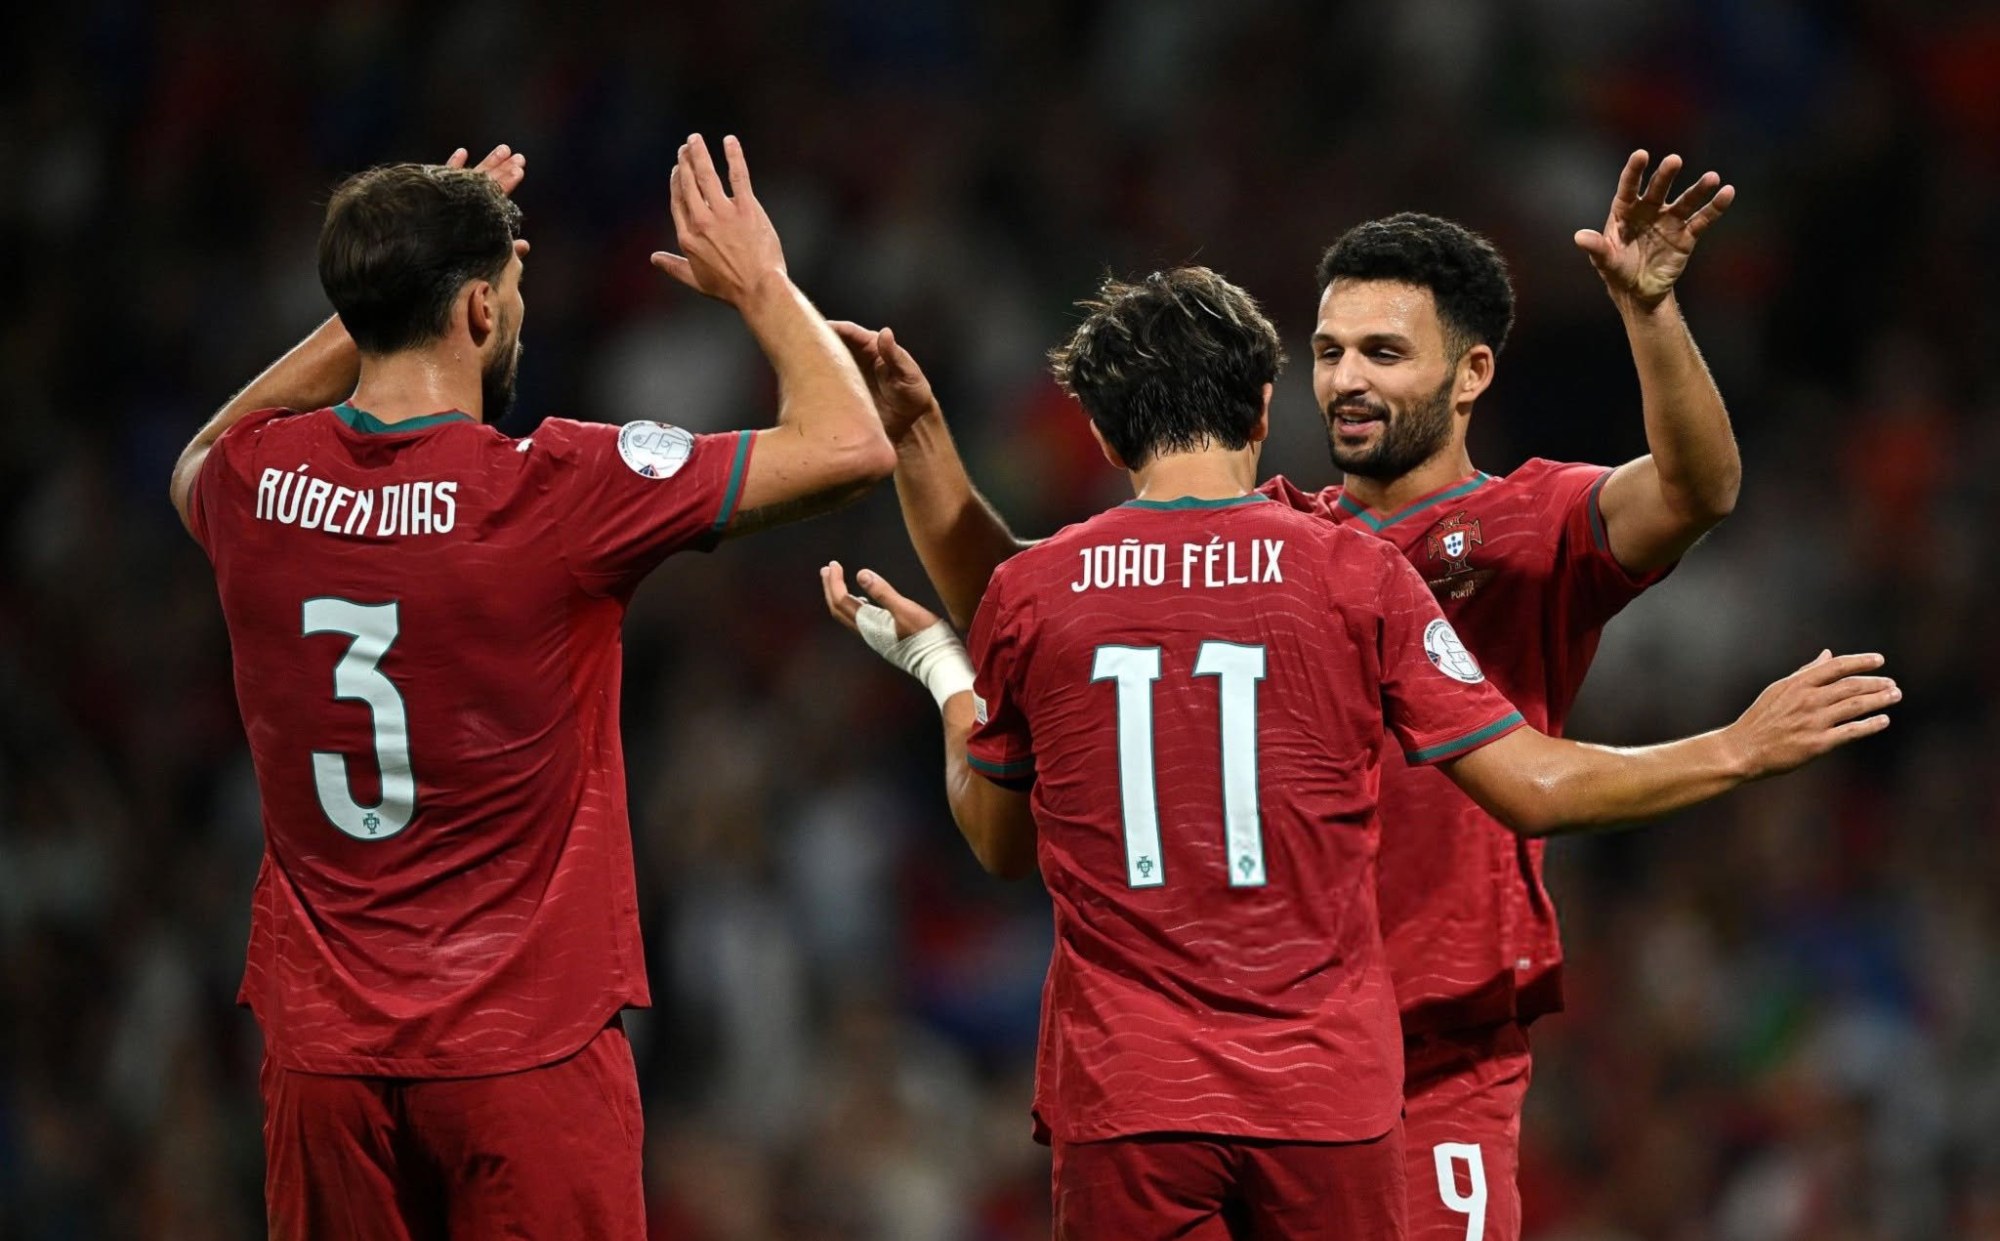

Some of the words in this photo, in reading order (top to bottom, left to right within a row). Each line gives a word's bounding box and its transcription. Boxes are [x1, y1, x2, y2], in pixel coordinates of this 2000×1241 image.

[256, 463, 373, 536] RÚBEN
[377, 481, 458, 537] DIAS
[1071, 538, 1166, 593] JOÃO
[1182, 535, 1285, 589] FÉLIX
[302, 597, 416, 841] 3
[1090, 641, 1267, 889] 11
[1432, 1142, 1487, 1241] 9
